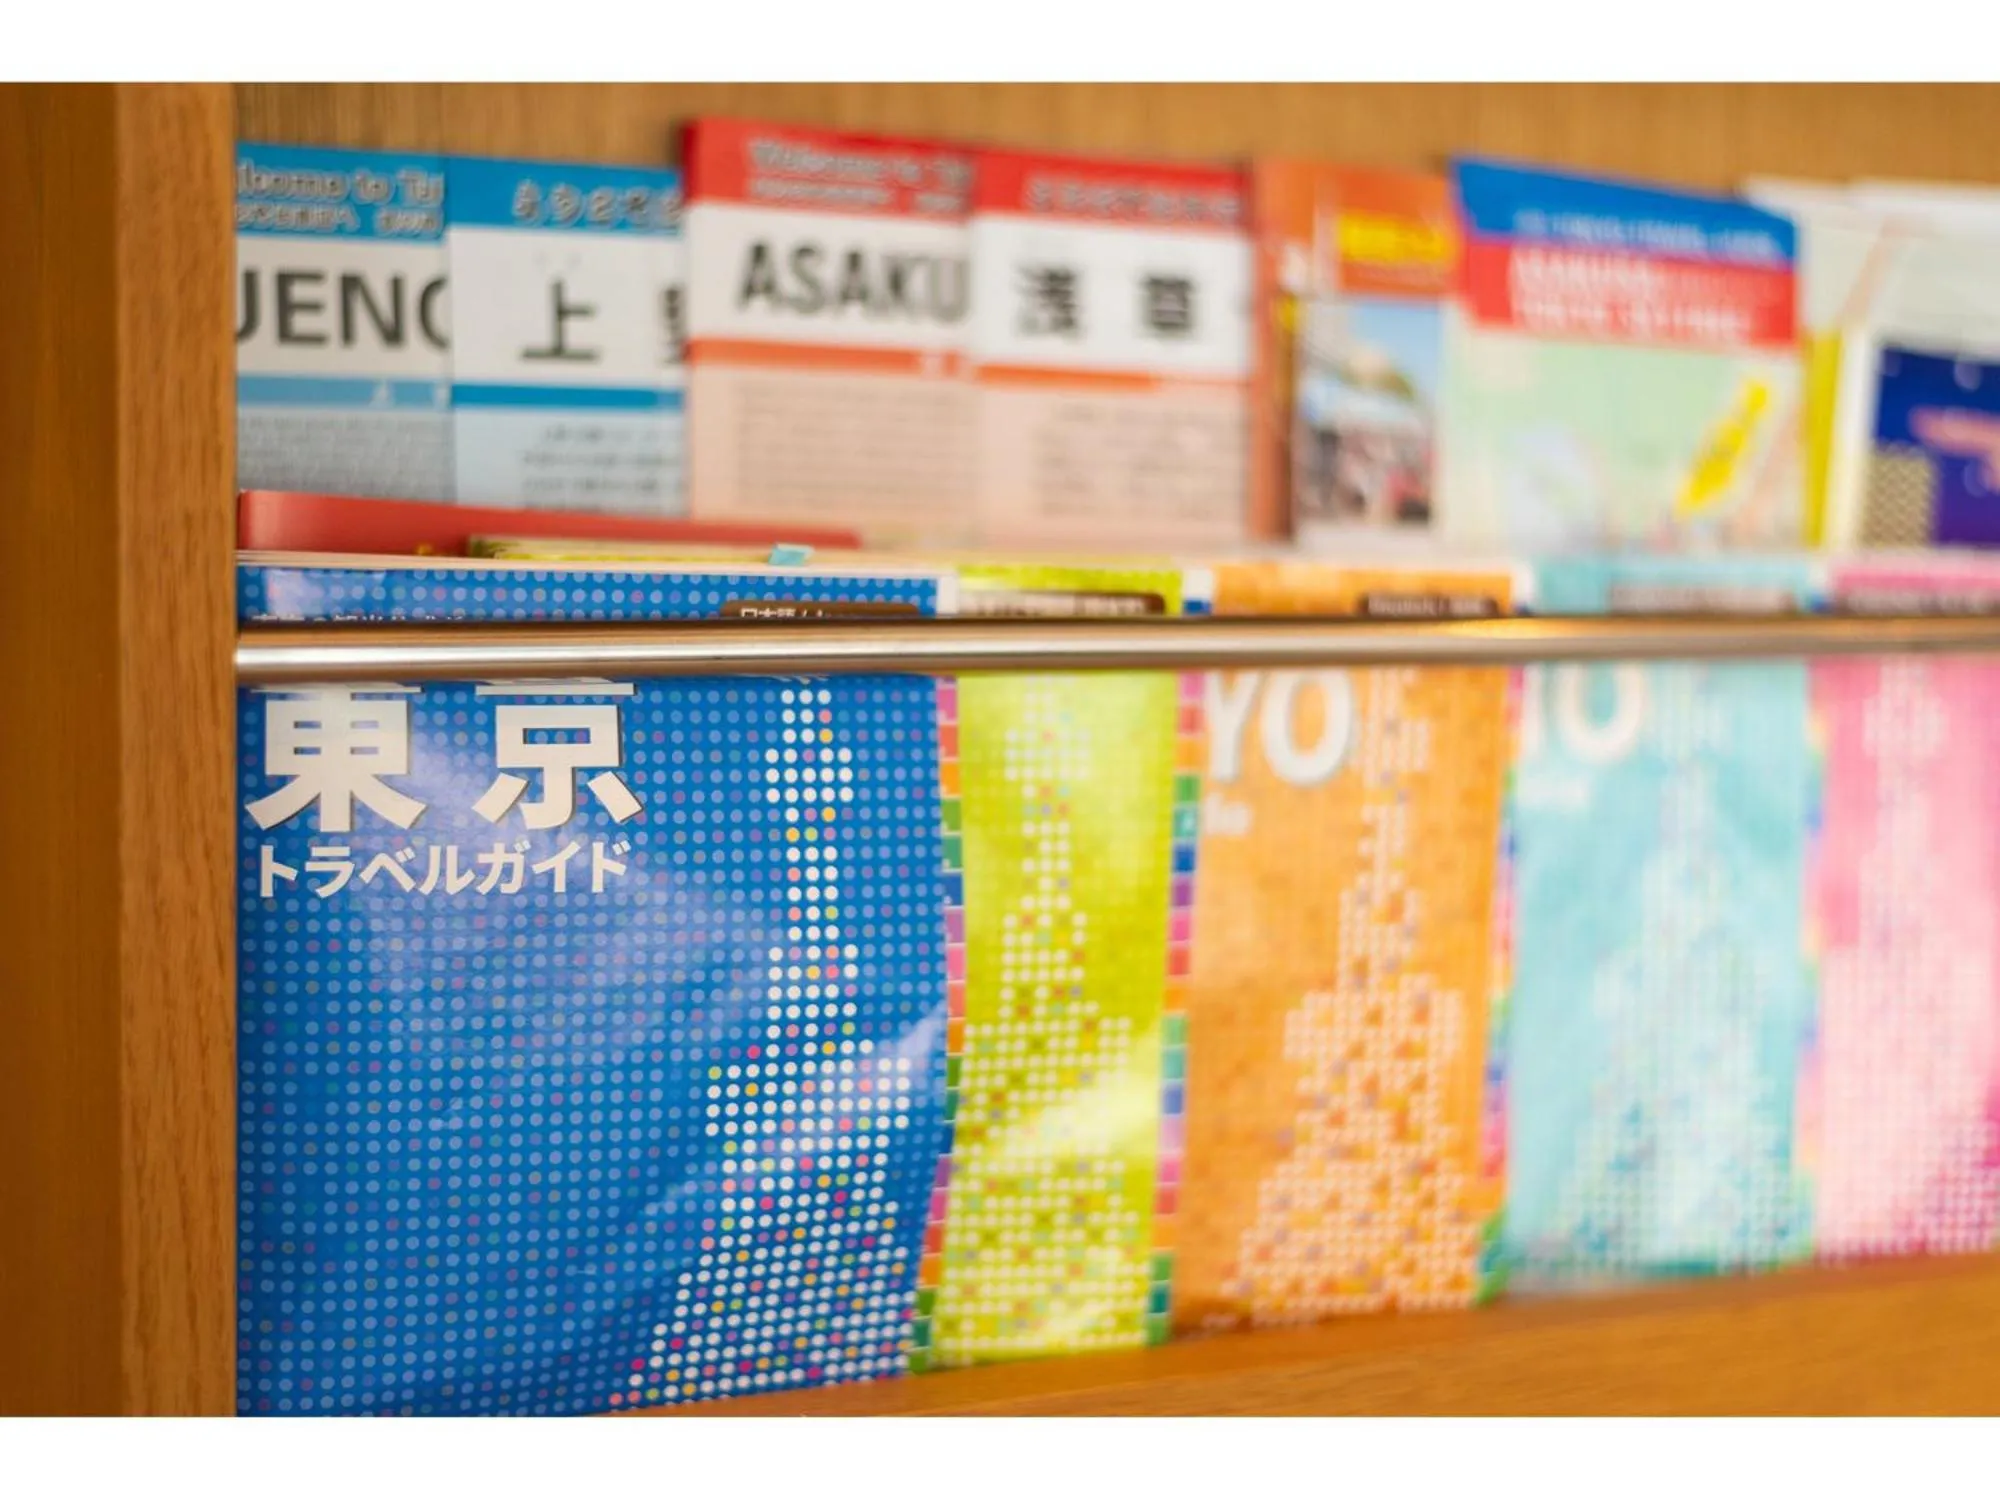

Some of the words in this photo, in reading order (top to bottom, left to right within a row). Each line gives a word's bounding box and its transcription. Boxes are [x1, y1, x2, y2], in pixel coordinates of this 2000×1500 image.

[245, 680, 643, 832] 東京
[259, 838, 632, 898] トラベルガイド
